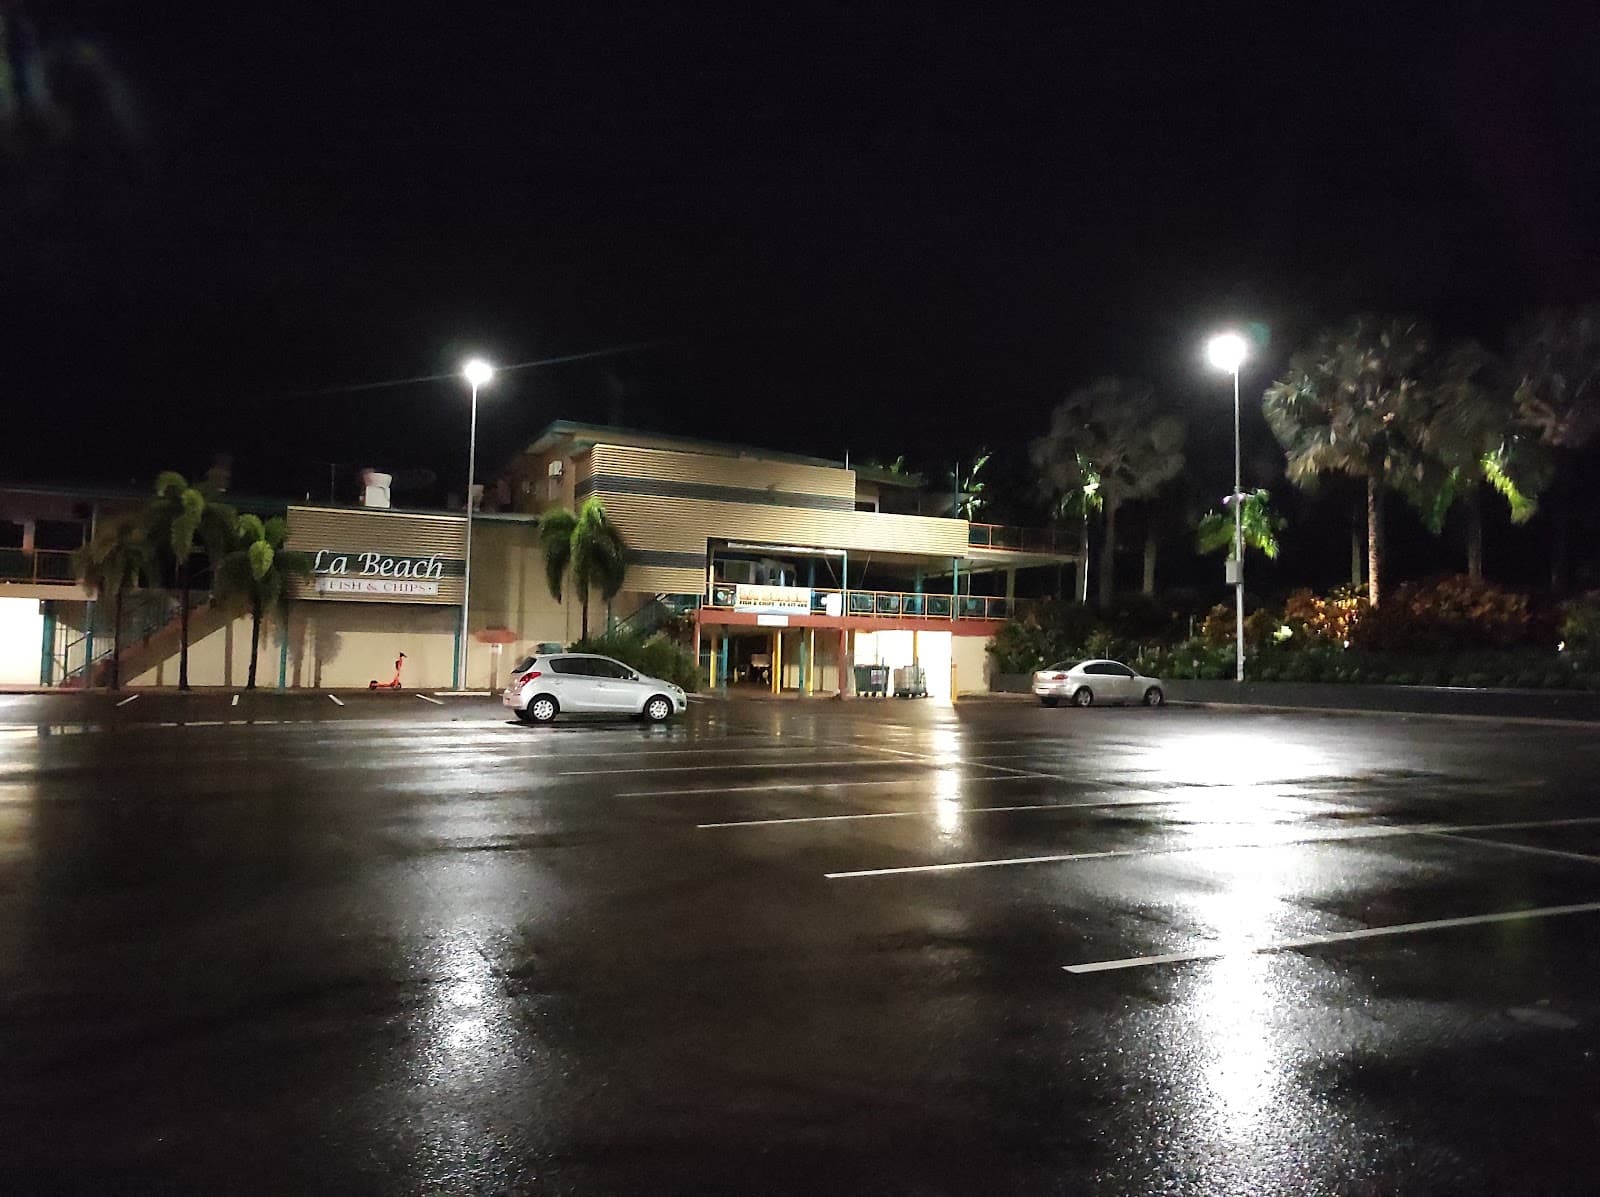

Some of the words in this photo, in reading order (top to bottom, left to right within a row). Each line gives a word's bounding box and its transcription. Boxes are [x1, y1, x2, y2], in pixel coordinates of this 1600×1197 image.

[310, 549, 349, 575] La
[358, 552, 444, 580] Beach
[329, 581, 361, 591] FISH
[366, 583, 377, 592] &
[383, 582, 426, 593] CHIPS
